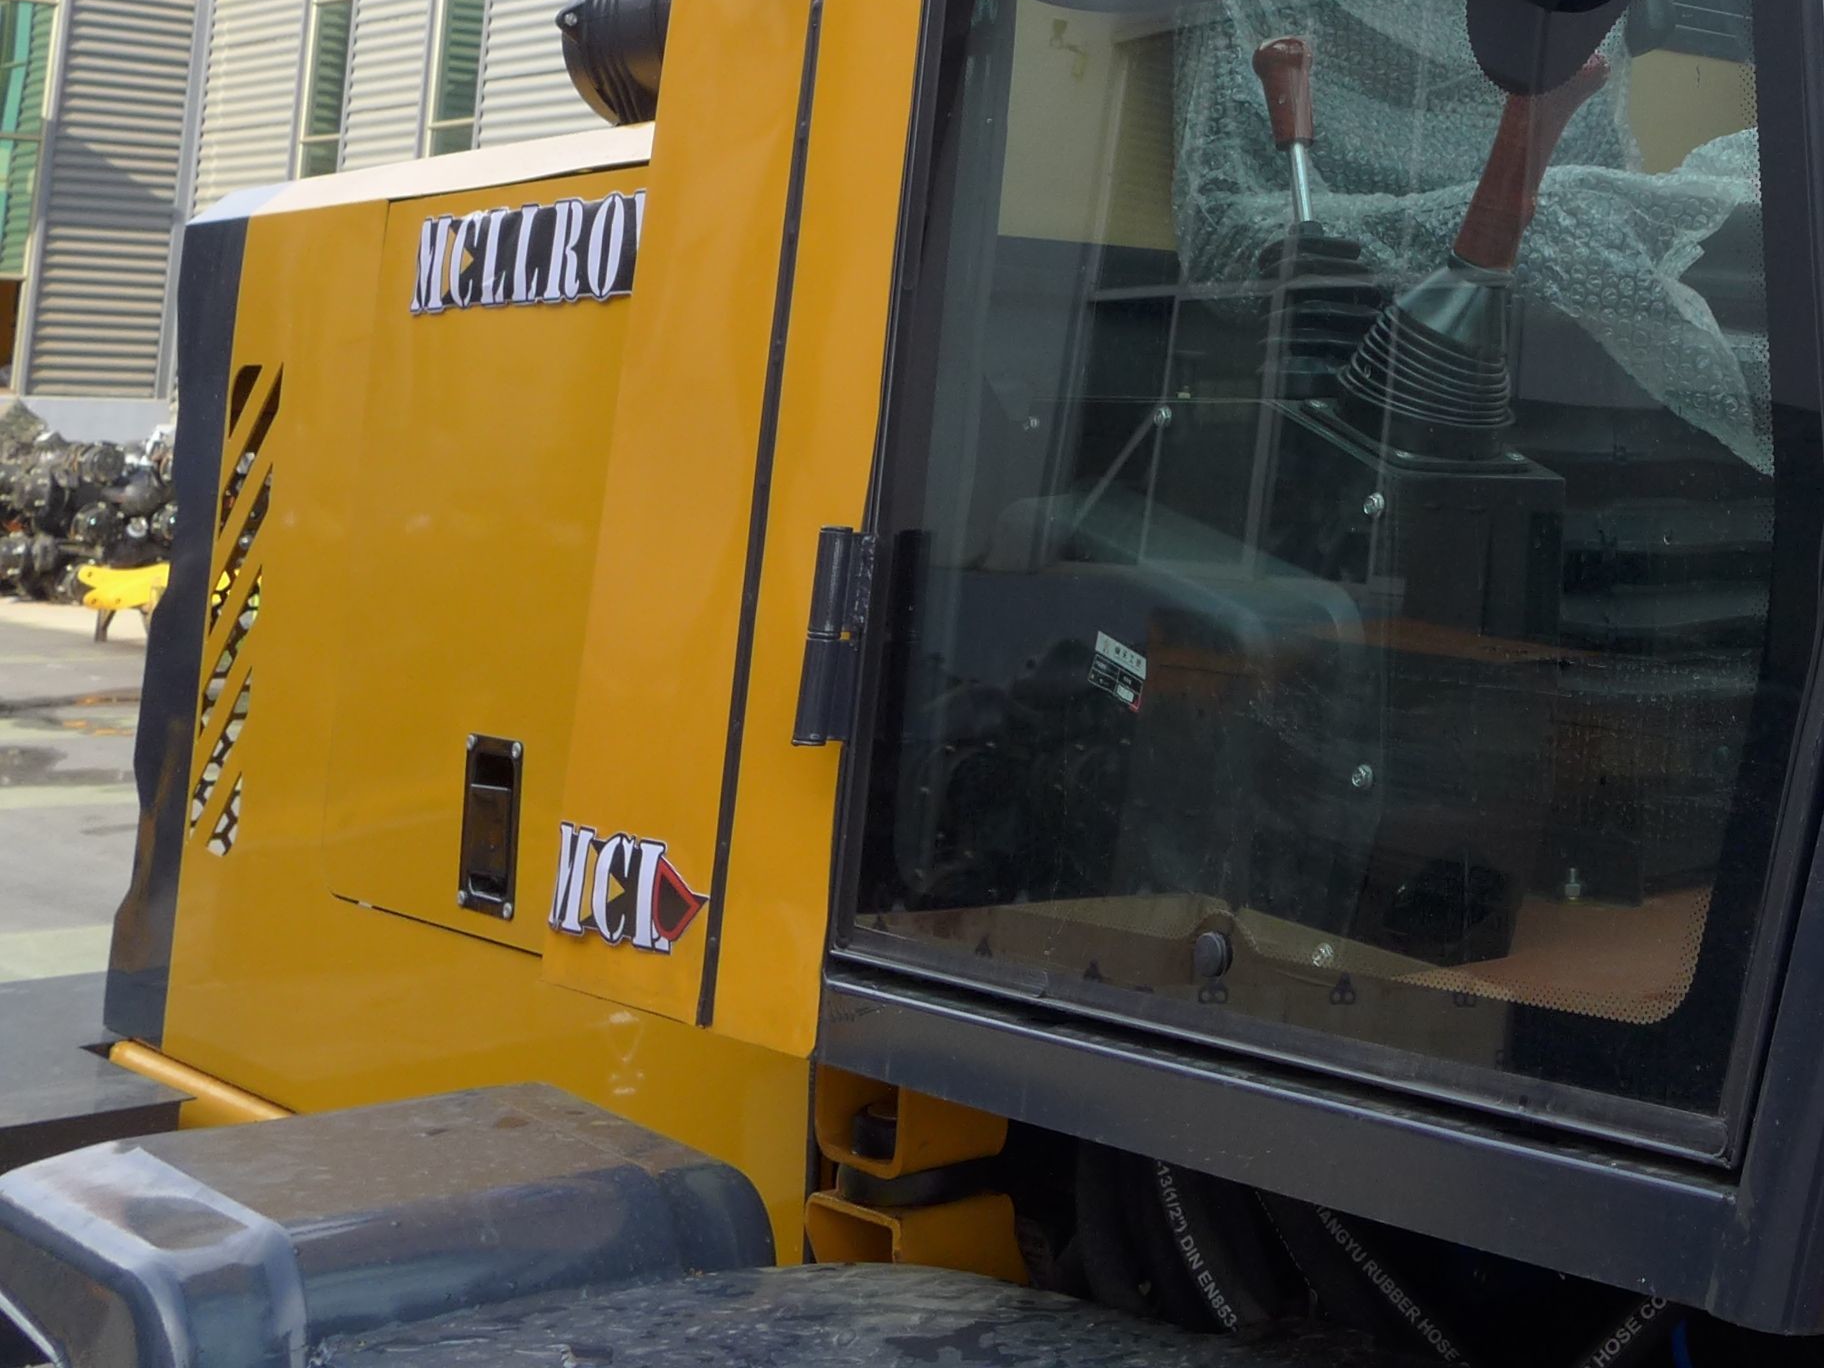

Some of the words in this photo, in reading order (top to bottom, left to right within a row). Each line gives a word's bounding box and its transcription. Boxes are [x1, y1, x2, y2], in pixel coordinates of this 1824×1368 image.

[1179, 1234, 1204, 1271] DIN
[1362, 1259, 1422, 1324] RUBBER
[1418, 1316, 1461, 1363] HOSE
[1593, 1315, 1643, 1368] HOSE
